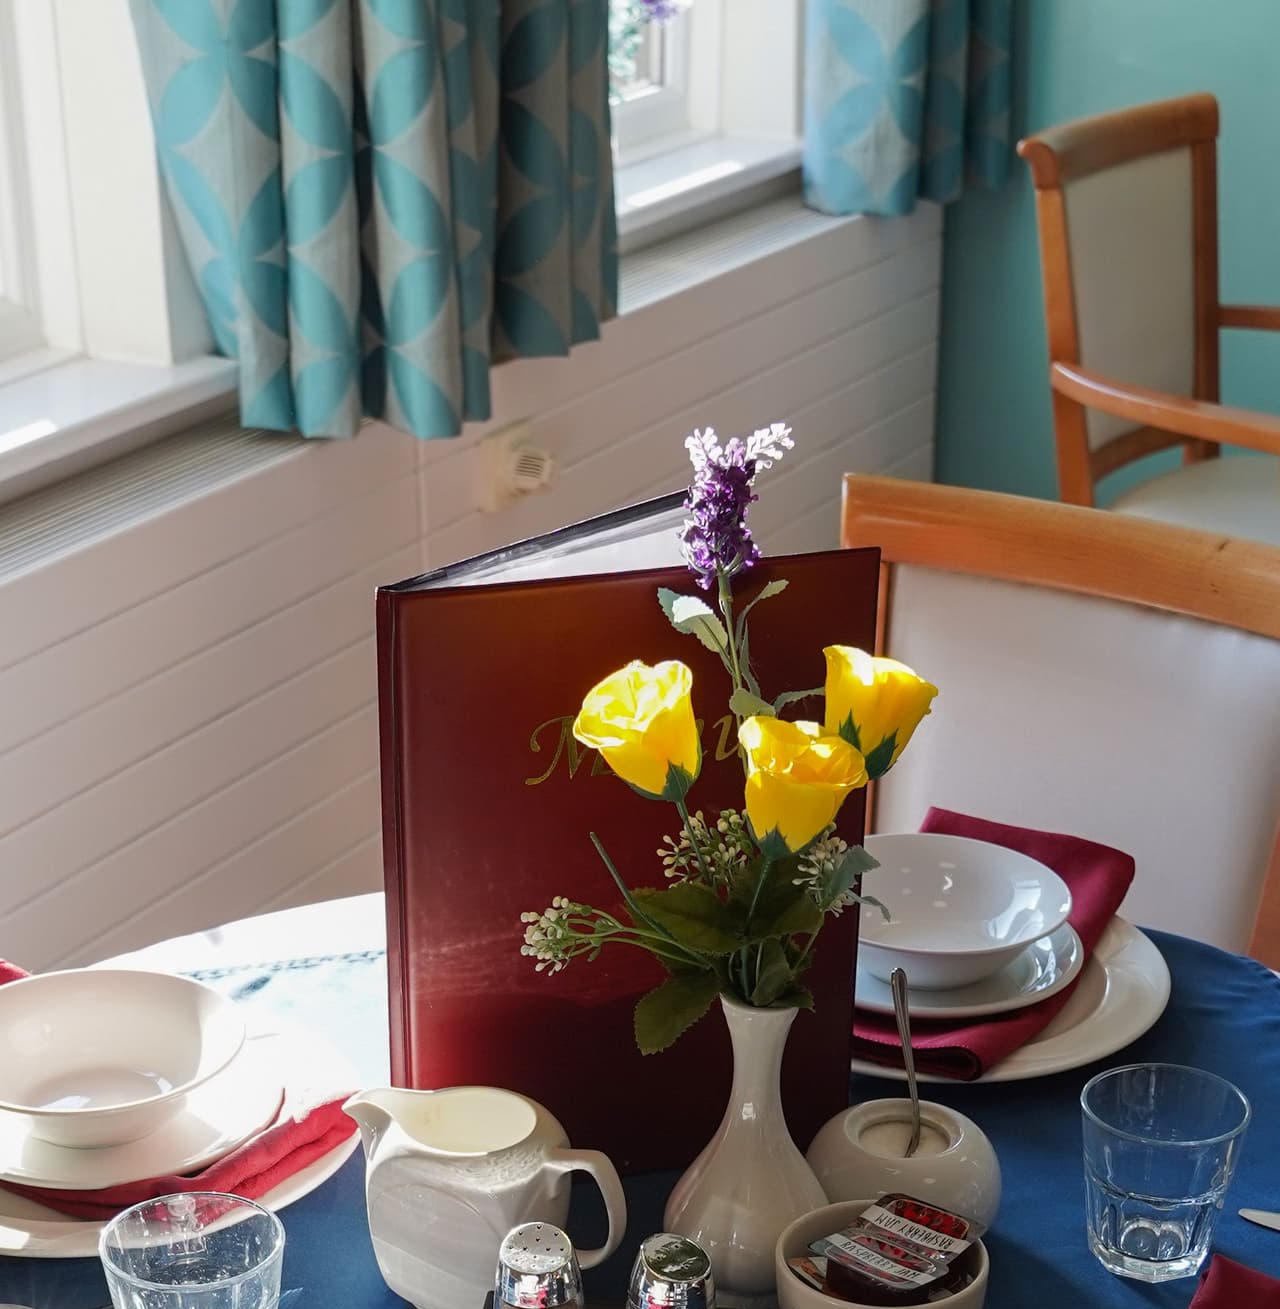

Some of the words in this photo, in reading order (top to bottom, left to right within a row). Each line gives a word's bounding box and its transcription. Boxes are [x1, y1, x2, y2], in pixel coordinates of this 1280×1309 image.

[525, 714, 745, 785] Mu
[875, 1213, 901, 1228] JAM
[899, 1223, 954, 1249] RASPBERRY
[840, 1241, 895, 1270] RASPBERRY
[893, 1267, 920, 1279] JAM
